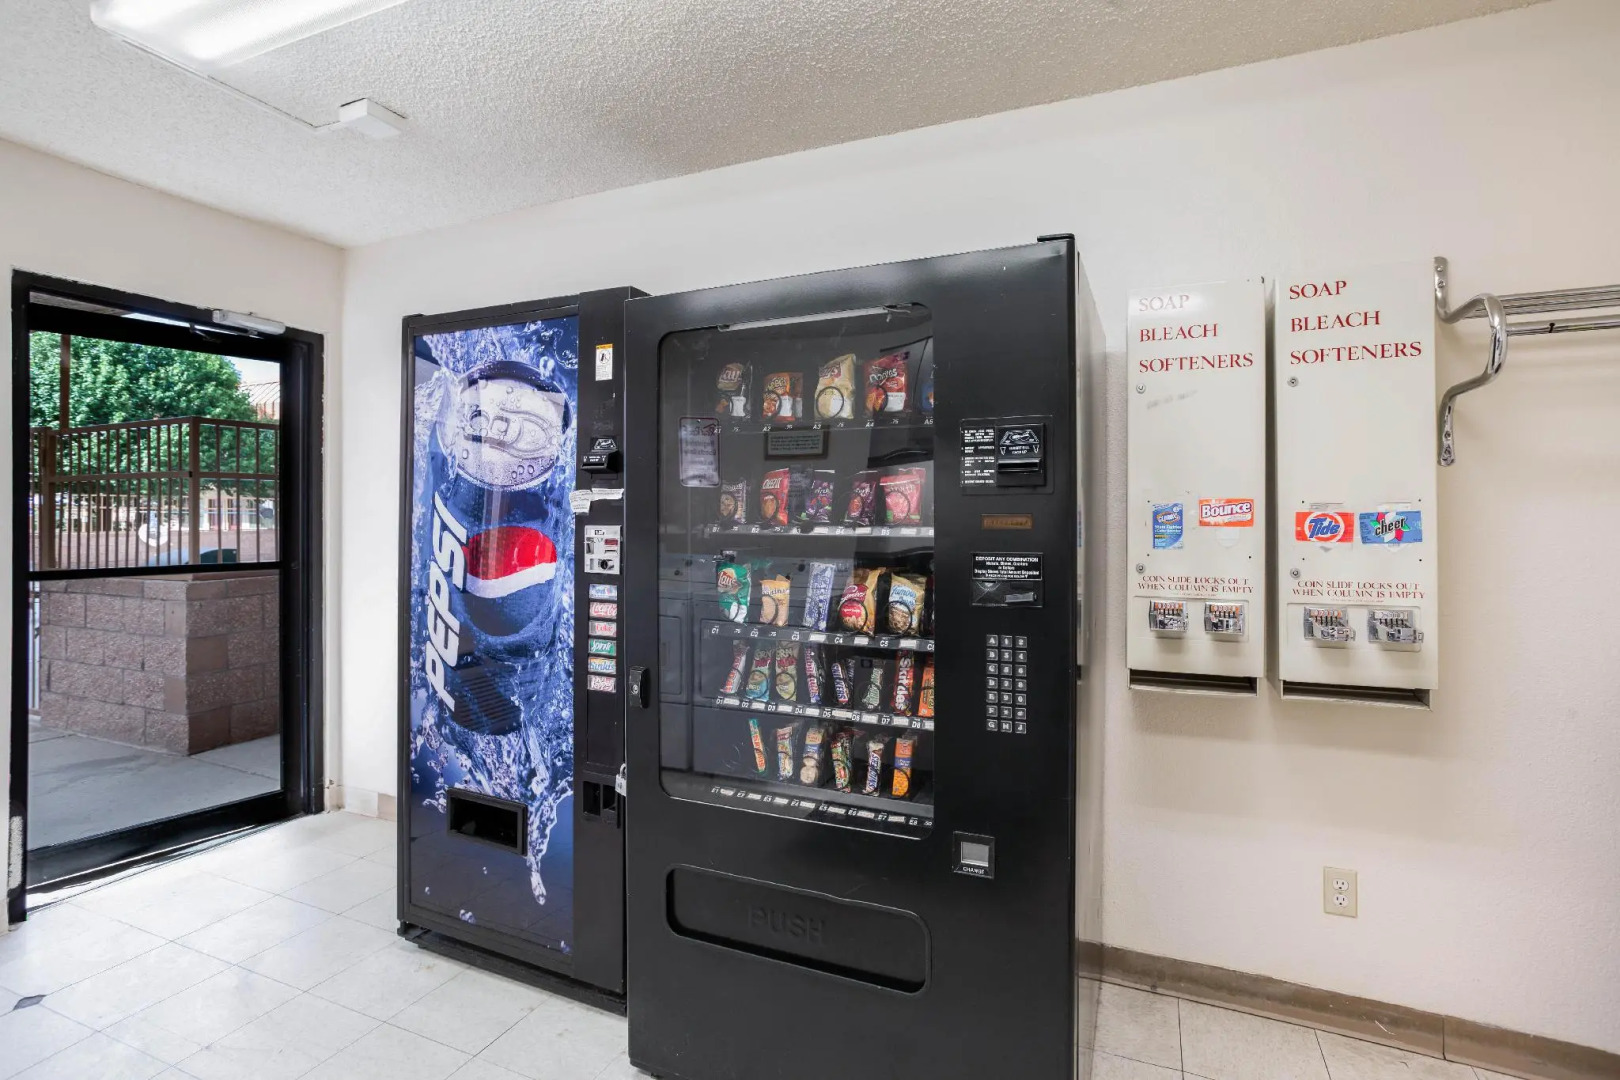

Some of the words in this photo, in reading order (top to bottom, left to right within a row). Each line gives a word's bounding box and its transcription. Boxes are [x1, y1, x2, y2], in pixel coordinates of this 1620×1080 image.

[1289, 280, 1347, 300] SOAP
[1139, 294, 1190, 312] SOAP
[1291, 310, 1380, 332] BLEACH
[1140, 323, 1218, 342] BLEACH
[1139, 352, 1254, 373] SOFTENERS
[1290, 341, 1422, 365] SOFTENERS
[1201, 502, 1252, 519] Bounce
[1308, 517, 1341, 539] Tide
[1375, 517, 1405, 536] cheer
[1168, 584, 1208, 592] COLUMN
[1222, 586, 1254, 594] EMPTY
[1194, 577, 1226, 585] LOCKS
[1227, 577, 1249, 586] OUT
[1297, 580, 1323, 588] COIN
[1326, 581, 1353, 589] SLIDE
[1357, 582, 1392, 590] LOCKS
[1396, 582, 1420, 590] OUT
[425, 490, 468, 713] PEPSI
[1292, 588, 1323, 596] WHEN
[1327, 589, 1373, 597] COLUMN
[1377, 590, 1385, 598] IS
[1389, 591, 1425, 599] EMPTY
[1003, 722, 1009, 730] H
[747, 905, 826, 944] PUSH
